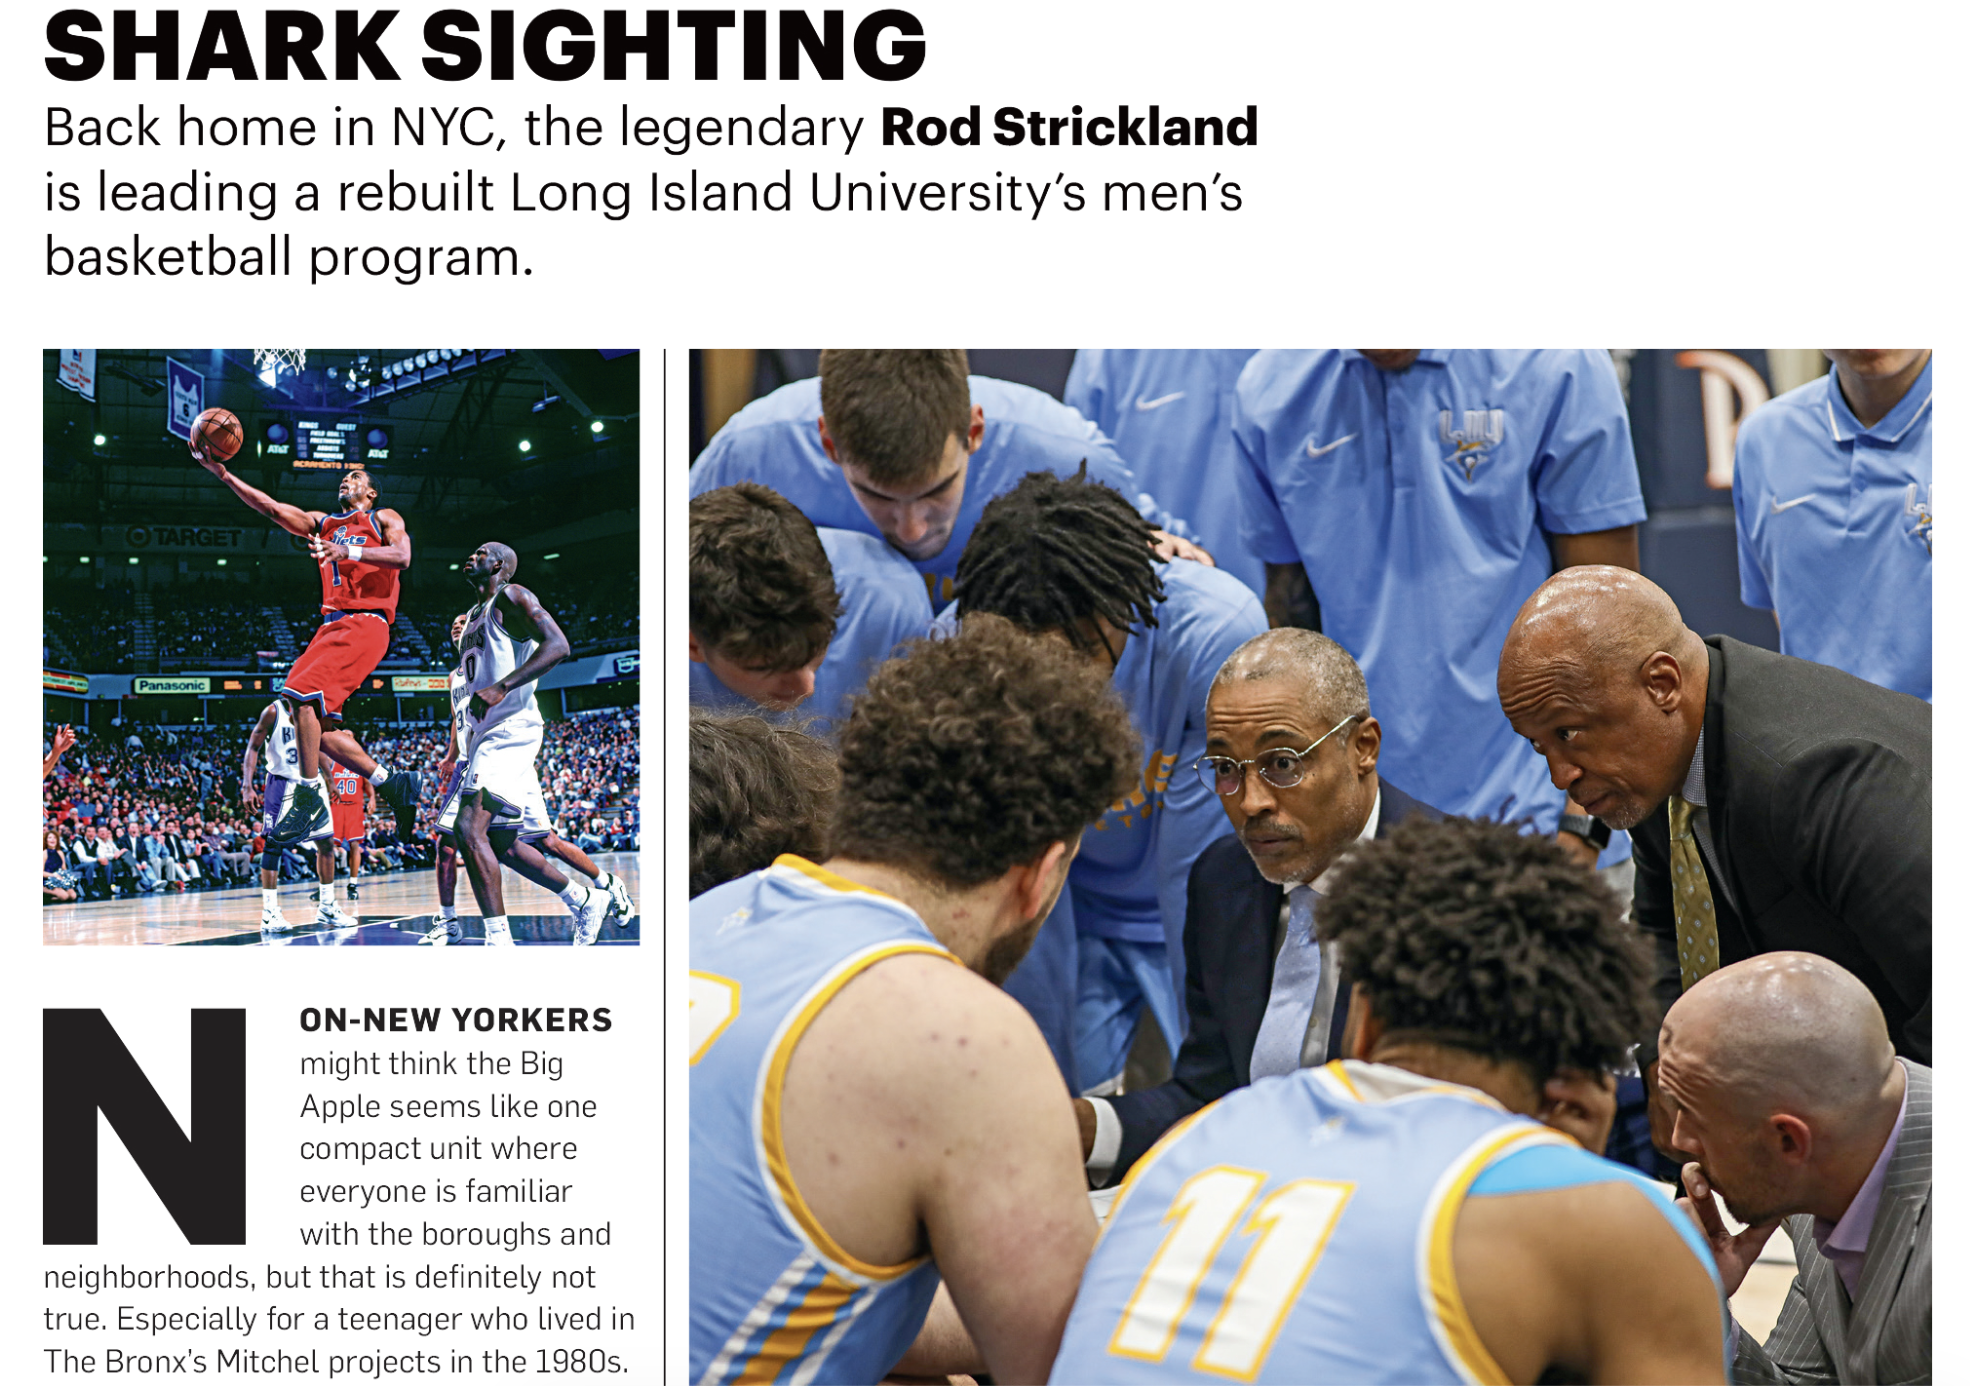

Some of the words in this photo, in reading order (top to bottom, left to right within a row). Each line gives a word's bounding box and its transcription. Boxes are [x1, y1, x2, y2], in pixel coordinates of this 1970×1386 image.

[44, 9, 401, 81] SHARK
[421, 9, 926, 81] SIGHTING
[47, 104, 161, 146] Back
[179, 104, 315, 146] home
[334, 106, 373, 145] in
[394, 107, 505, 151] NYC,
[524, 104, 602, 146] the
[622, 104, 864, 155] legendary
[882, 105, 980, 146] Rod
[992, 105, 1257, 146] Strickland
[46, 171, 80, 211] is
[99, 169, 275, 220] leading
[294, 182, 318, 211] a
[340, 169, 494, 211] rebuilt
[513, 172, 629, 220] Long
[651, 169, 790, 211] Island
[811, 171, 1085, 220] University’s
[1104, 172, 1242, 211] men’s
[46, 234, 289, 276] basketball
[311, 246, 532, 285] program.
[267, 444, 290, 454] AT&T
[367, 449, 389, 459] AT&T
[154, 527, 242, 547] TARGET
[139, 680, 205, 691] Panasonic
[336, 779, 357, 795] 40
[299, 1008, 441, 1032] ON-NEW
[450, 1008, 612, 1032] YORKERS
[301, 1051, 380, 1081] might
[388, 1051, 457, 1074] think
[466, 1051, 510, 1075] the
[521, 1051, 562, 1081] Big
[299, 1094, 380, 1123] Apple
[390, 1100, 480, 1117] seems
[491, 1094, 538, 1117] like
[548, 1100, 596, 1117] one
[42, 1008, 246, 1245] N
[300, 1137, 421, 1165] compact
[430, 1136, 482, 1159] unit
[490, 1136, 577, 1159] where
[300, 1185, 425, 1209] everyone
[436, 1178, 456, 1202] is
[465, 1178, 572, 1202] familiar
[299, 1221, 358, 1245] with
[367, 1221, 412, 1245] the
[423, 1221, 550, 1251] boroughs
[560, 1221, 610, 1245] and
[44, 1264, 255, 1294] neighborhoods,
[267, 1264, 311, 1288] but
[319, 1264, 375, 1288] that
[386, 1264, 405, 1288] is
[415, 1264, 541, 1294] definitely
[552, 1266, 596, 1288] not
[1107, 1164, 1357, 1380] 11
[43, 1308, 106, 1330] true.
[118, 1306, 257, 1336] Especially
[266, 1306, 304, 1330] for
[314, 1313, 328, 1330] a
[337, 1308, 462, 1336] teenager
[470, 1306, 527, 1330] who
[539, 1306, 600, 1330] lived
[612, 1306, 634, 1330] in
[43, 1349, 95, 1373] The
[106, 1349, 206, 1373] Bronx’s
[217, 1349, 319, 1373] Mitchel
[329, 1349, 440, 1379] projects
[451, 1349, 472, 1373] in
[481, 1349, 526, 1373] the
[536, 1349, 627, 1373] 1980s.
